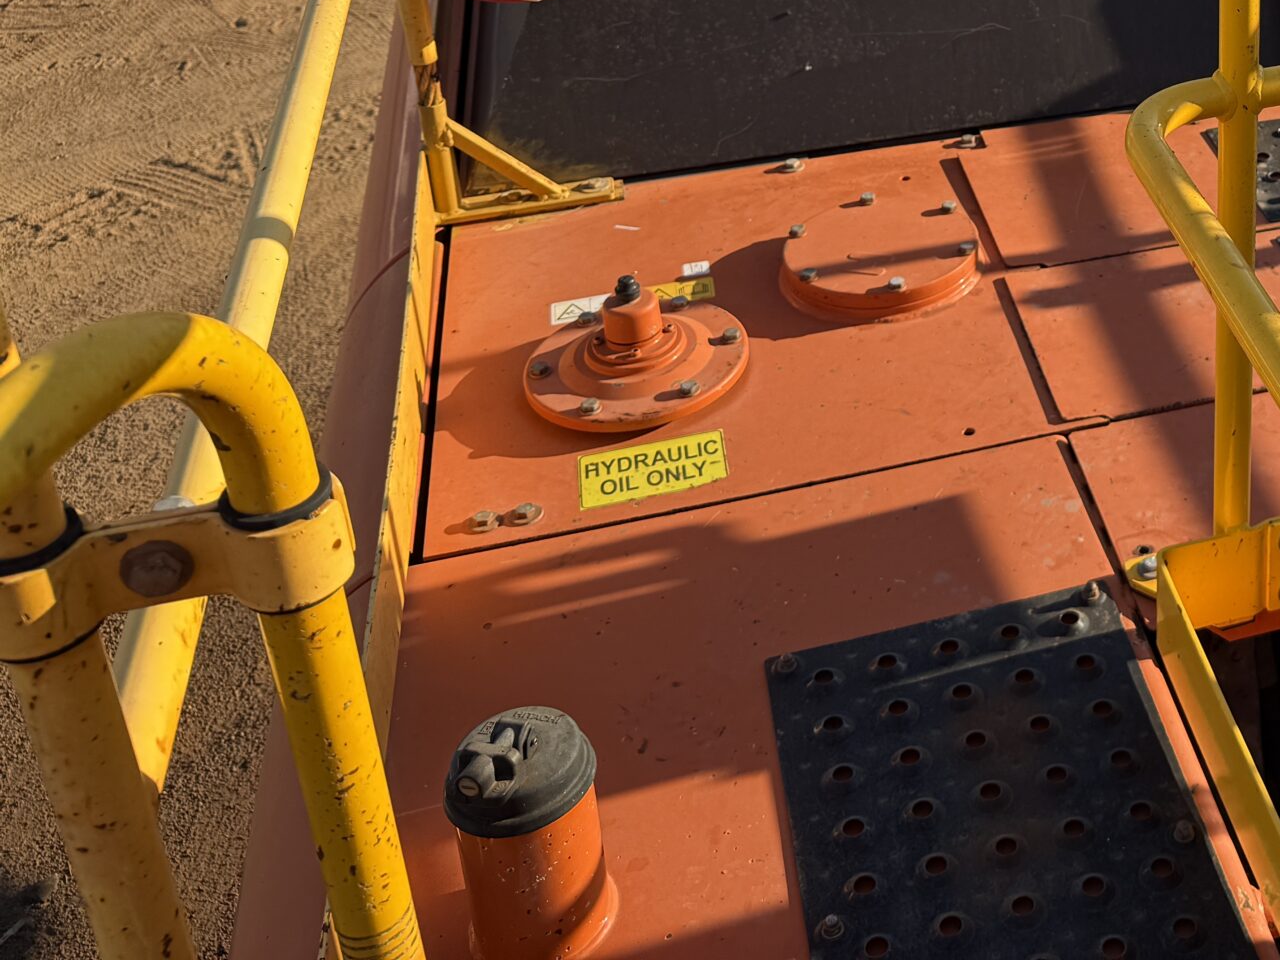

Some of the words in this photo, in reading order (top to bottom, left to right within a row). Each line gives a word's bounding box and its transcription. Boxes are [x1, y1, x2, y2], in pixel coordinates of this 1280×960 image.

[585, 440, 719, 479] HYDRAULIC
[600, 475, 639, 495] OIL
[646, 460, 707, 486] ONLY
